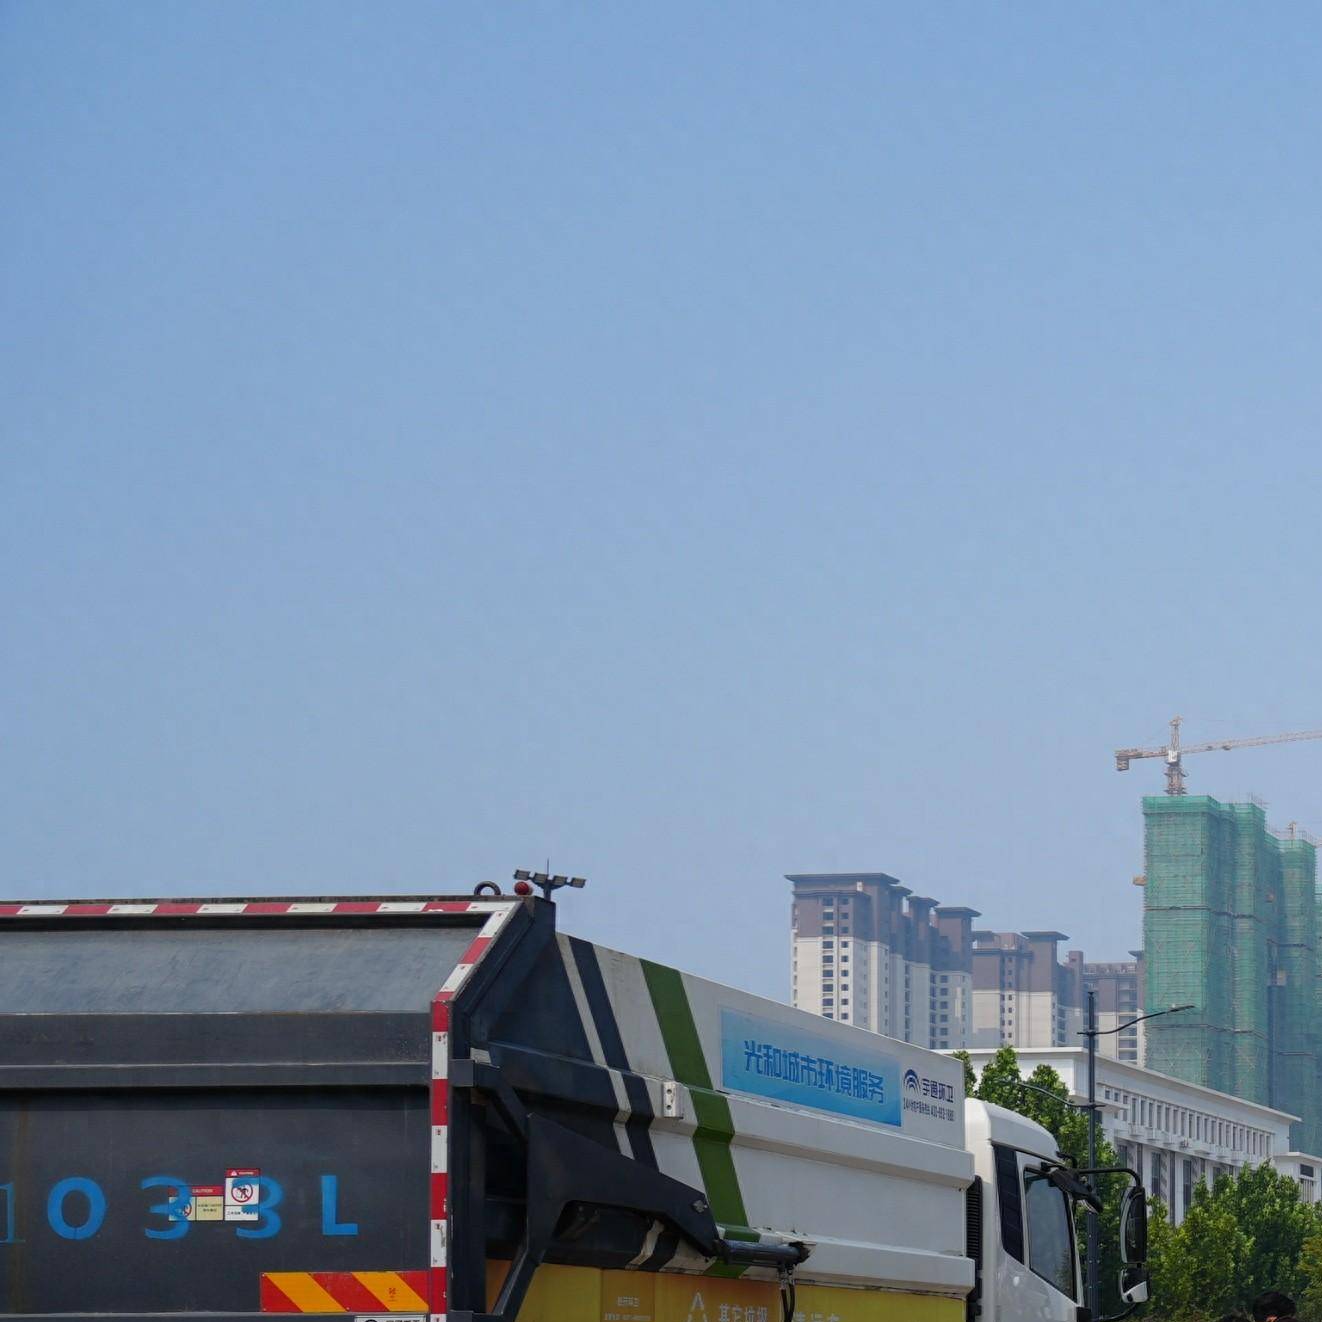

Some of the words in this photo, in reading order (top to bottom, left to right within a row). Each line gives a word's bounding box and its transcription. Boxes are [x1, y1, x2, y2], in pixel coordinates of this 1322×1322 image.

[743, 1039, 884, 1104] 光和城市环境服务
[922, 1078, 954, 1103] 宇通环卫
